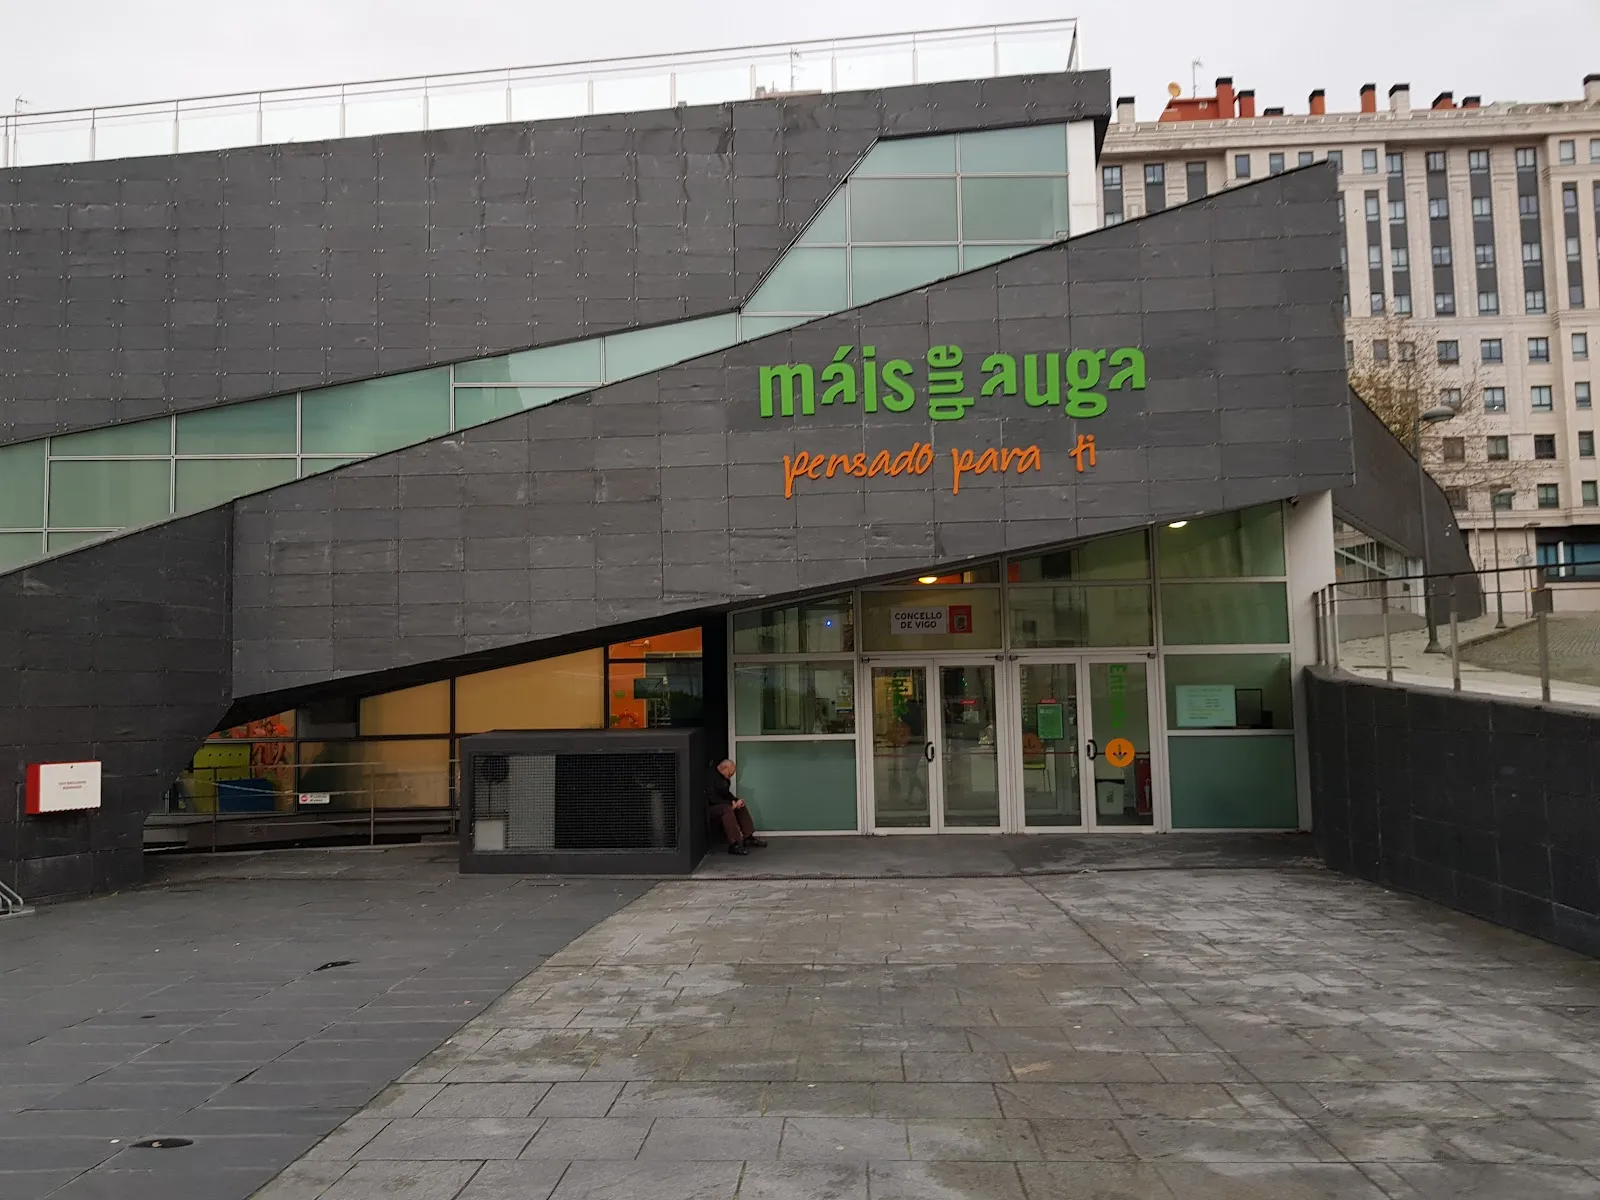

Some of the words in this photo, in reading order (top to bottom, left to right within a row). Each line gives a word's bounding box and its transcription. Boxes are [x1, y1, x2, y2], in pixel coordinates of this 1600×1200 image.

[759, 345, 916, 418] máis
[928, 344, 975, 421] que
[980, 347, 1147, 419] auga
[783, 442, 934, 499] pensado
[951, 444, 1040, 495] para
[1069, 434, 1097, 472] ti
[894, 611, 943, 620] CONCELLO
[900, 621, 913, 629] DE
[915, 621, 937, 629] VIGO
